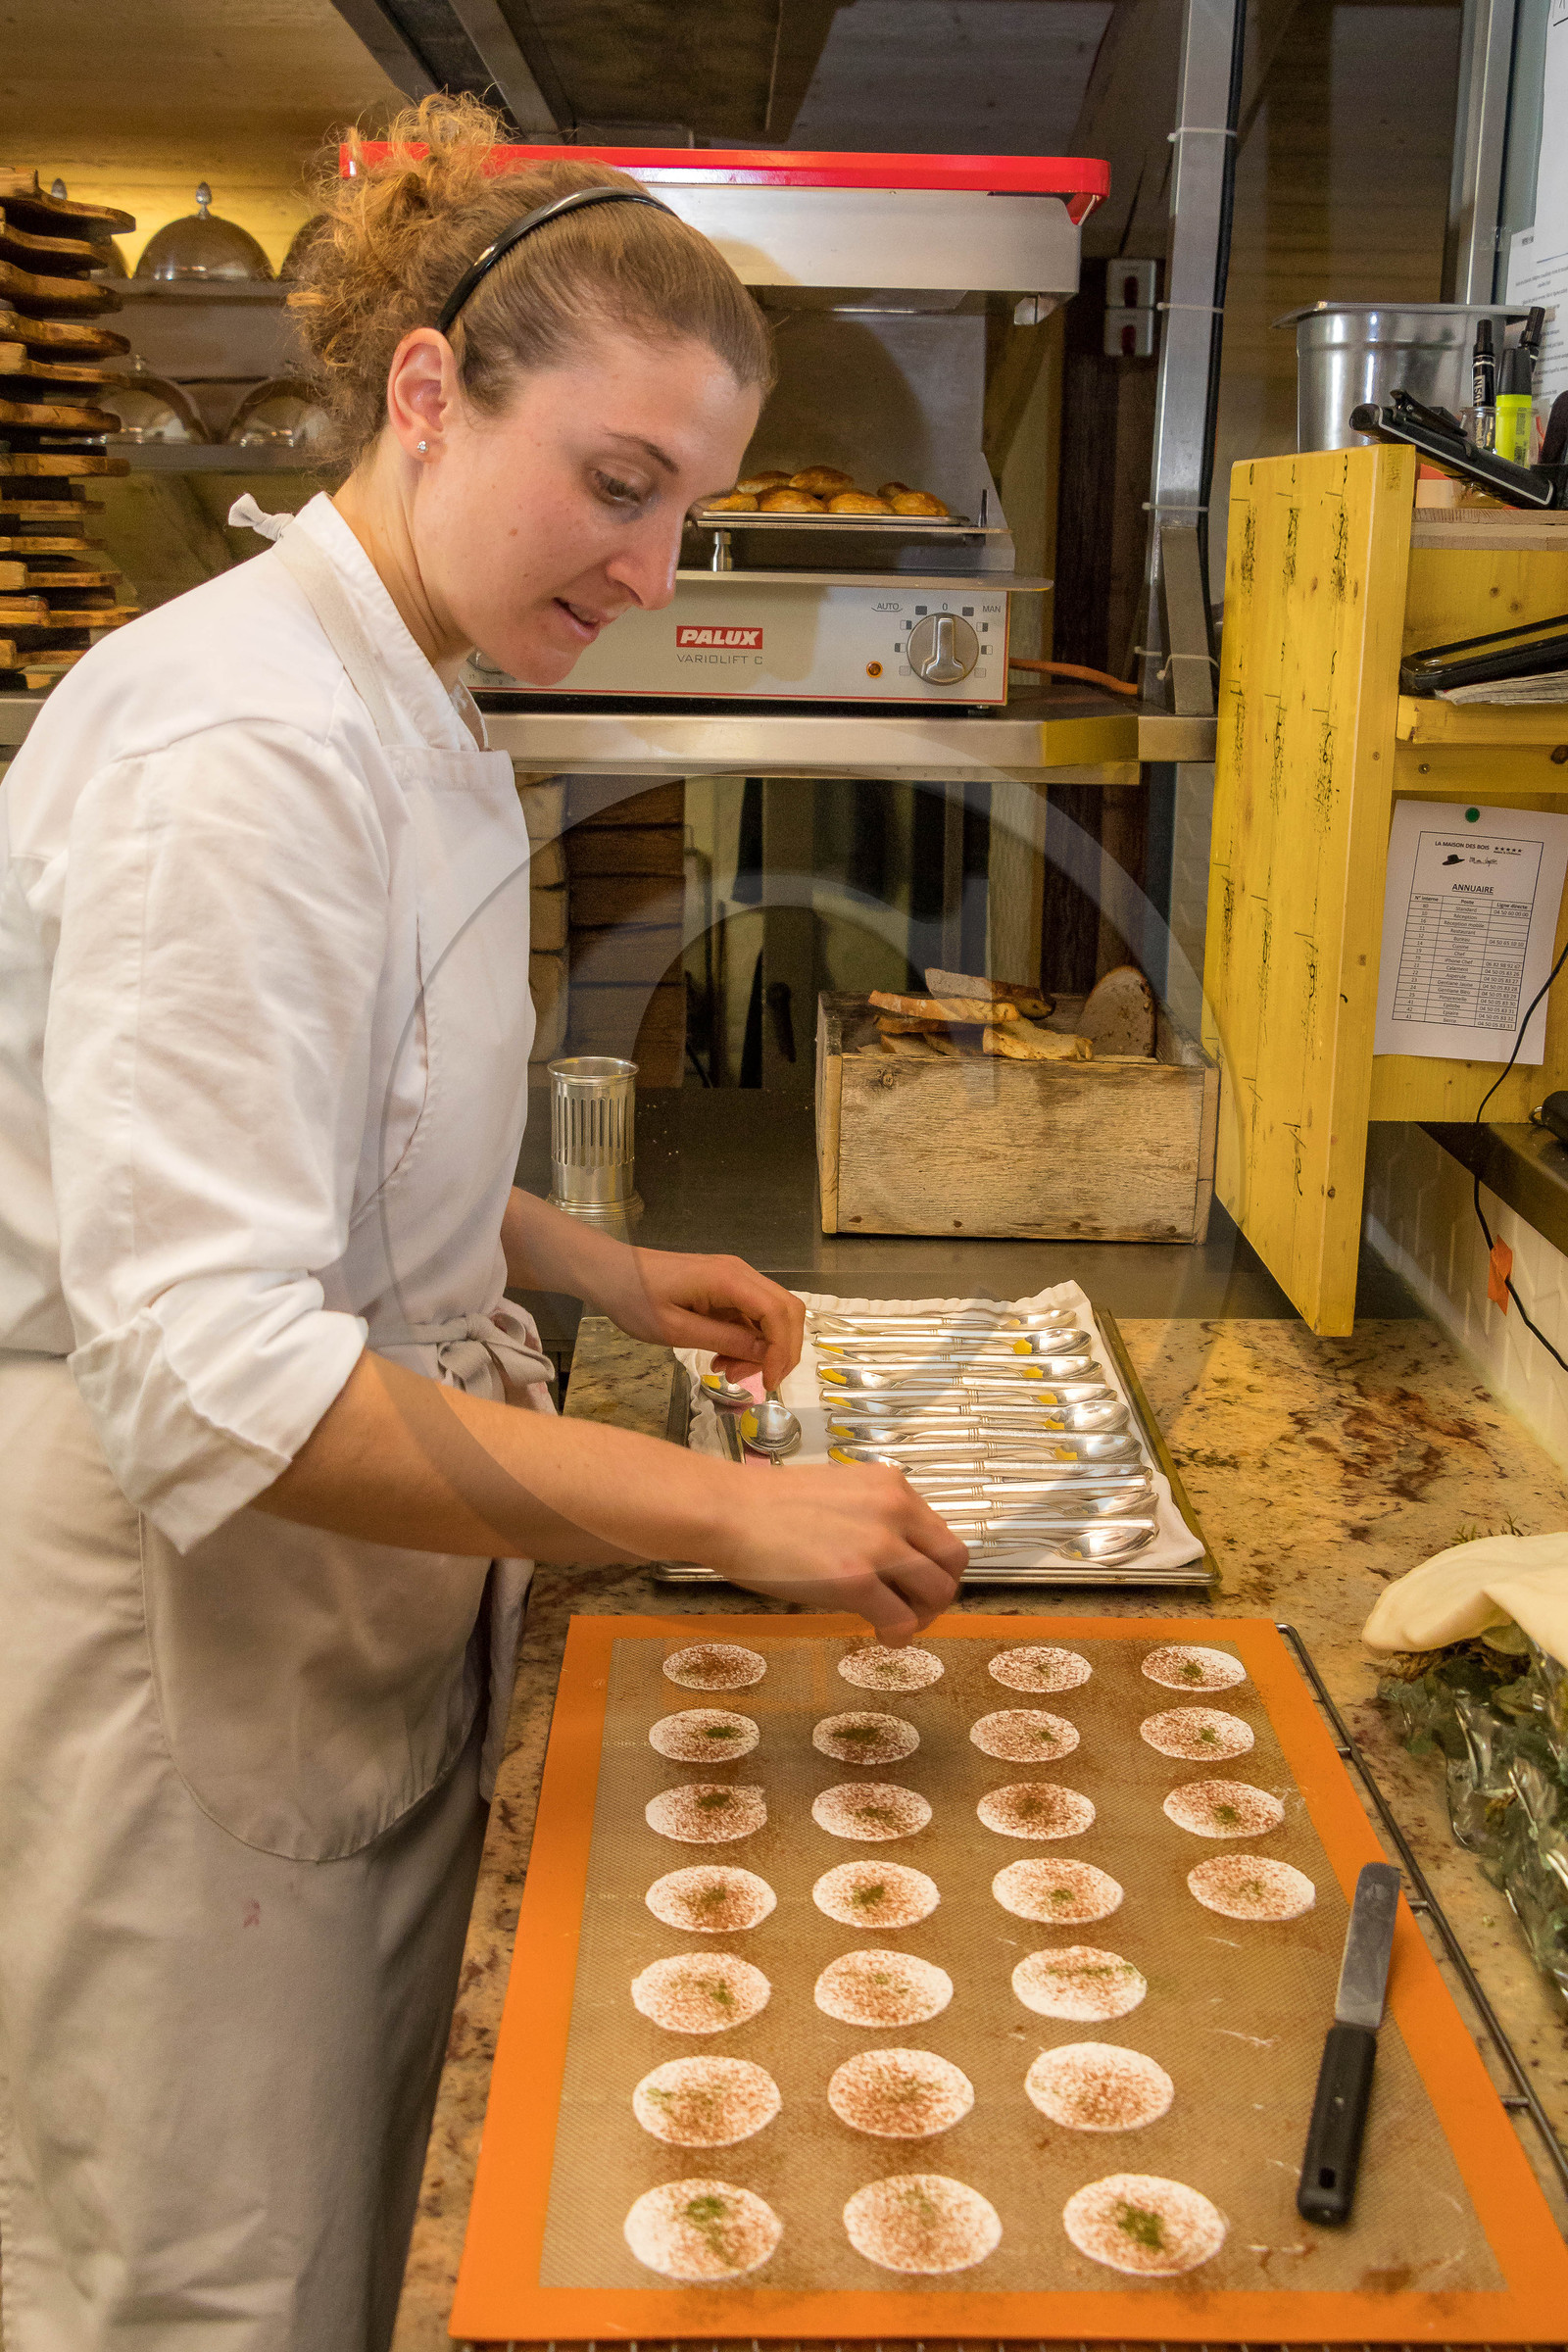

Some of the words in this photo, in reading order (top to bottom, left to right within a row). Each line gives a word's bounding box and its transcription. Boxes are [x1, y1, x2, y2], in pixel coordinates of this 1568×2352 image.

[876, 602, 900, 611] AUTO
[982, 605, 1002, 613] MAN
[679, 628, 761, 647] PALUX
[676, 654, 749, 665] VARIOLIFT
[754, 655, 763, 665] C
[1451, 883, 1494, 893] ANNUAIRE
